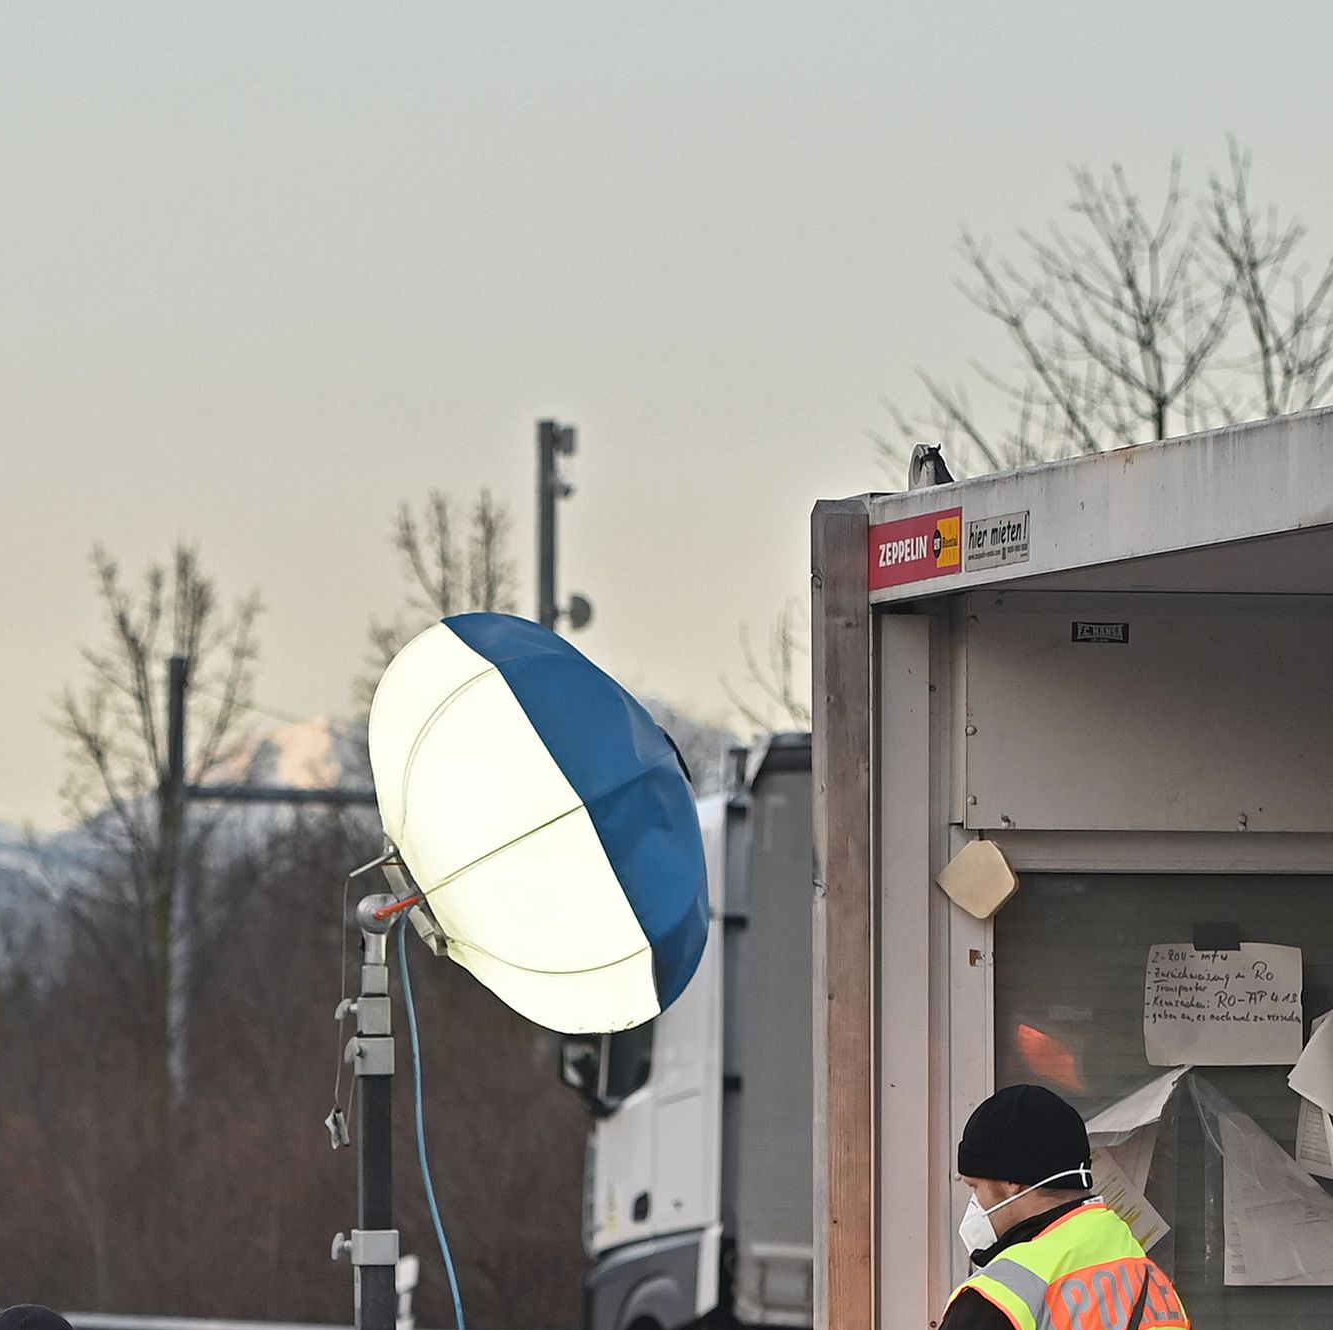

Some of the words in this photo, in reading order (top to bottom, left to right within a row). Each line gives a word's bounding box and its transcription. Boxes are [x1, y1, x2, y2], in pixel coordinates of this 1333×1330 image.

[968, 523, 987, 550] hier
[990, 512, 1029, 545] mieten!
[878, 535, 928, 568] ZEPPELIN
[1093, 625, 1123, 639] HANSA
[1156, 982, 1207, 998] Transporter
